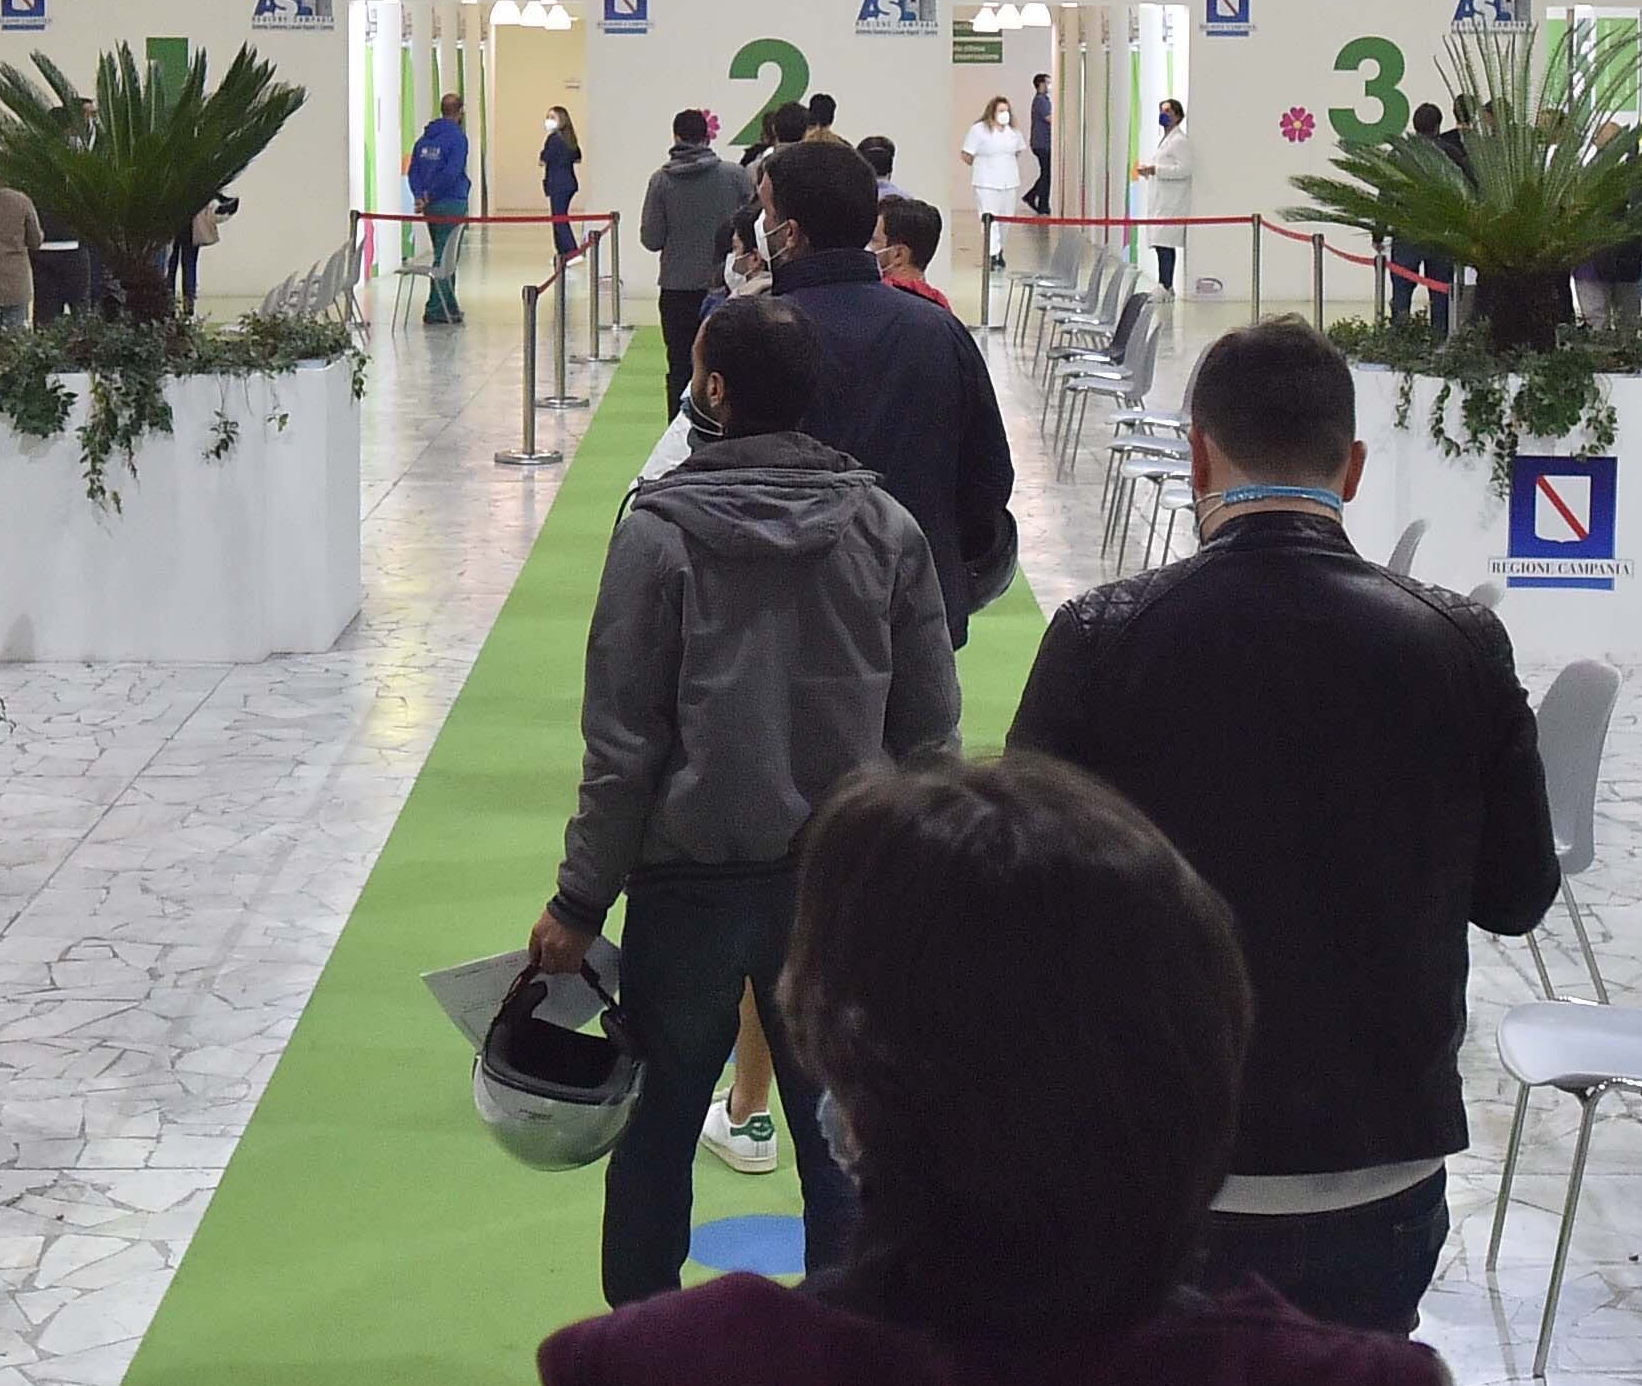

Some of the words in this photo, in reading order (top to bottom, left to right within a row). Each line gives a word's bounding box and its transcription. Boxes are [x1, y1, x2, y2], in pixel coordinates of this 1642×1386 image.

[727, 38, 810, 146] 2
[1327, 36, 1410, 151] 3
[1491, 562, 1555, 574] REGIONE
[1558, 562, 1631, 575] CAMPANIA
